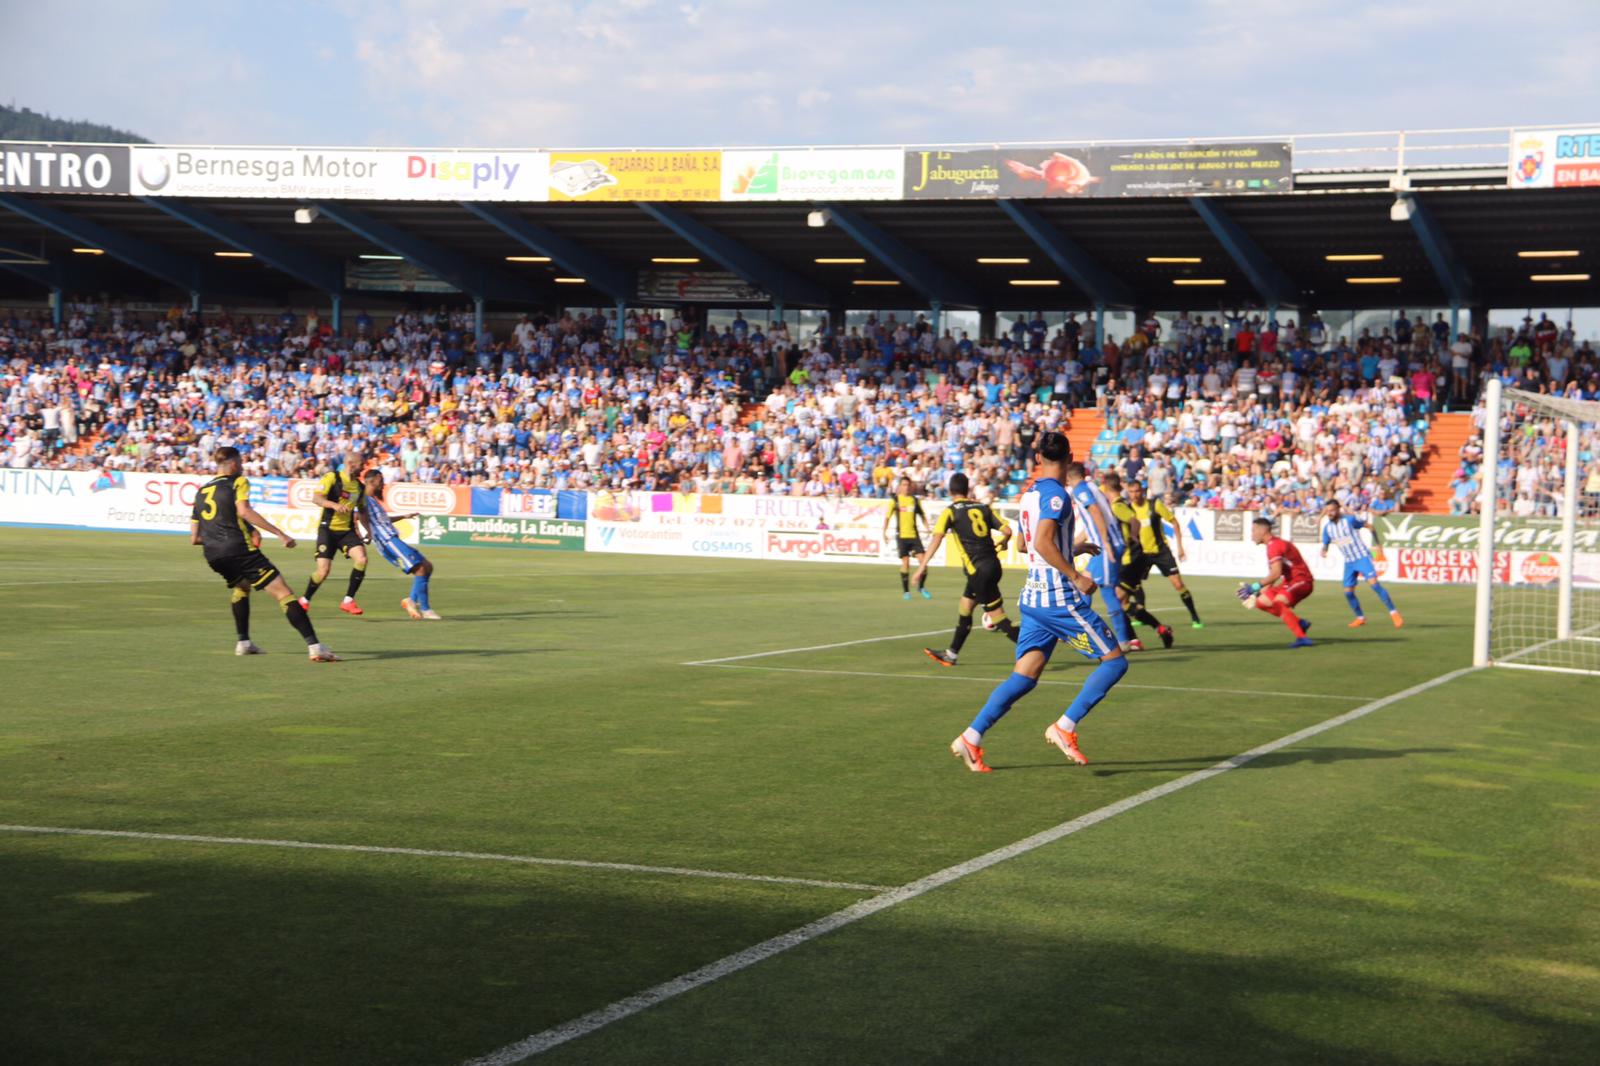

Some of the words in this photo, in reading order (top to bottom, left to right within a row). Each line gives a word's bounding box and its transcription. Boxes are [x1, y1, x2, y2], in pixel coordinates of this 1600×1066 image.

[609, 156, 655, 172] PIZARRAS
[659, 156, 669, 172] LA
[938, 151, 951, 160] La
[0, 152, 111, 188] NTRO
[176, 153, 294, 181] Bernesga
[303, 155, 378, 178] Motor
[407, 155, 520, 190] Disaply
[912, 151, 998, 191] Jabugueña
[200, 485, 217, 521] 3
[755, 498, 825, 518] FRUTAS
[448, 517, 519, 534] Embutidos
[520, 519, 537, 535] La
[539, 520, 585, 537] Encina
[968, 508, 987, 538] 8
[1217, 513, 1242, 527] AC
[619, 528, 682, 541] Votorantim
[691, 540, 753, 554] COSMOS
[1400, 549, 1509, 568] CONSERVS
[1405, 566, 1504, 583] VEGETALS
